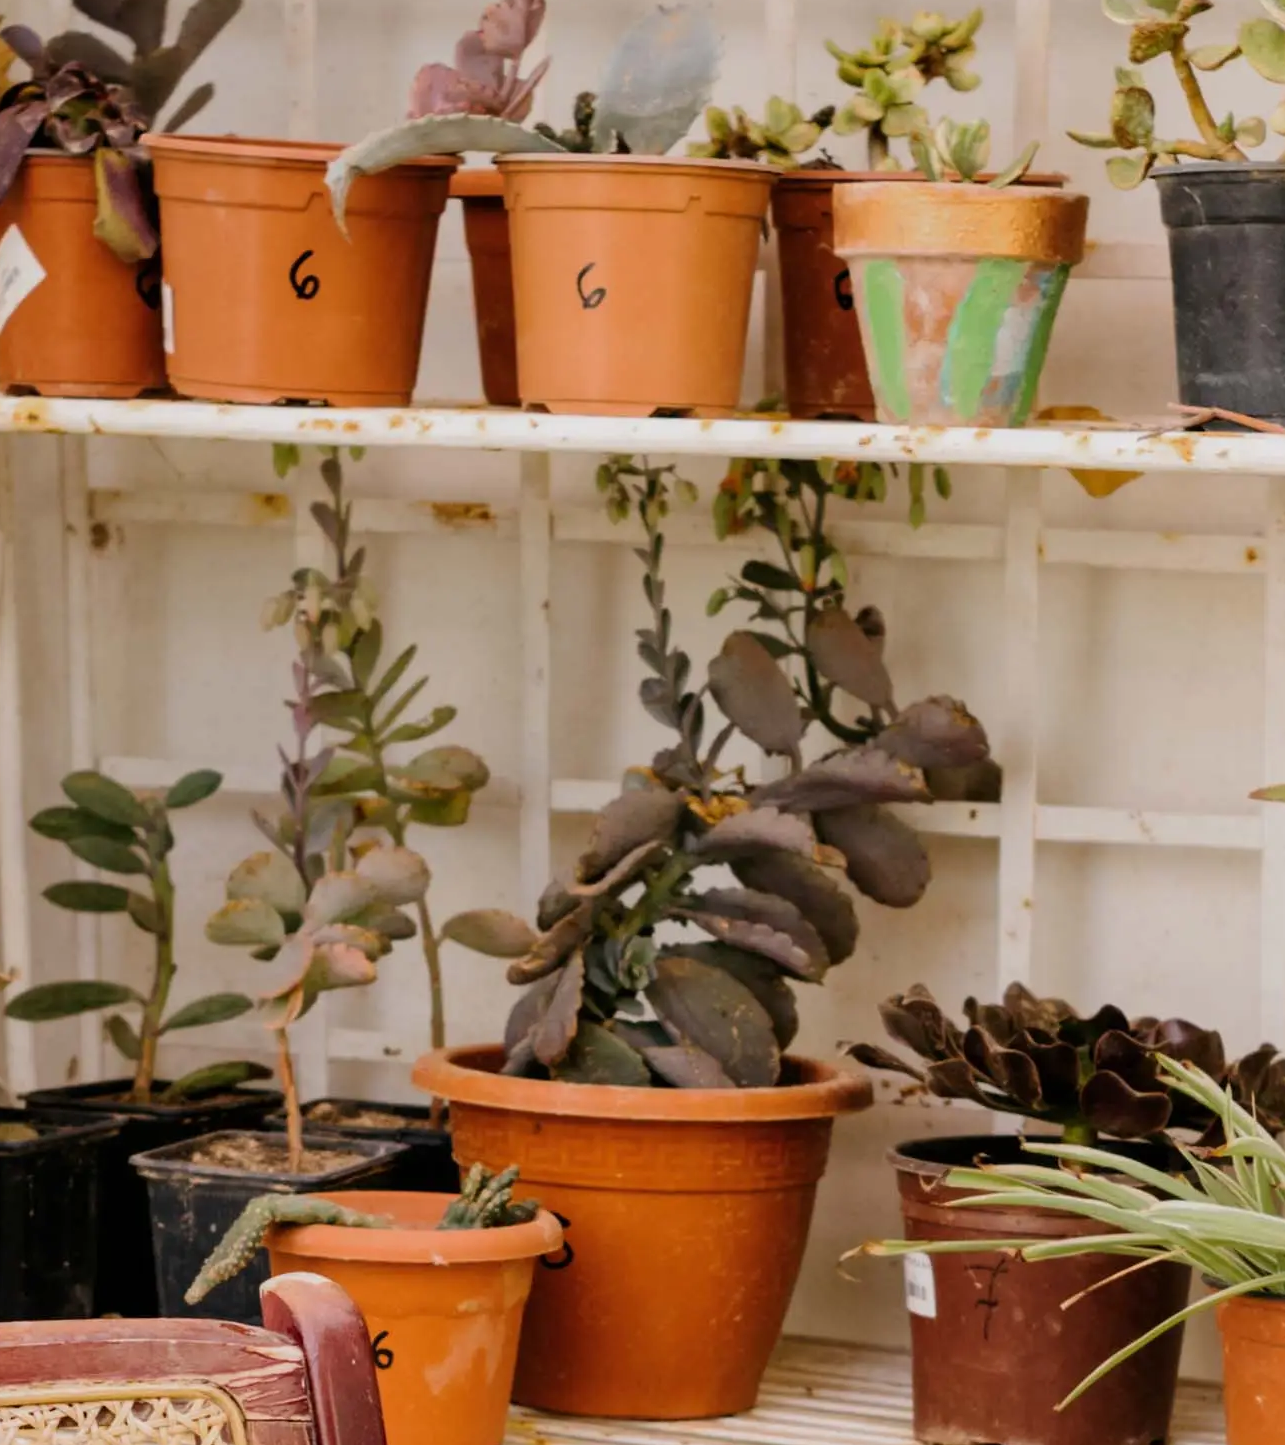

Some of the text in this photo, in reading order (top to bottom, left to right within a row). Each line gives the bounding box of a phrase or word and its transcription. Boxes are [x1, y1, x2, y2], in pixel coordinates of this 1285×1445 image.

[290, 250, 319, 299] 6
[577, 265, 605, 308] 6
[371, 1330, 394, 1370] 6
